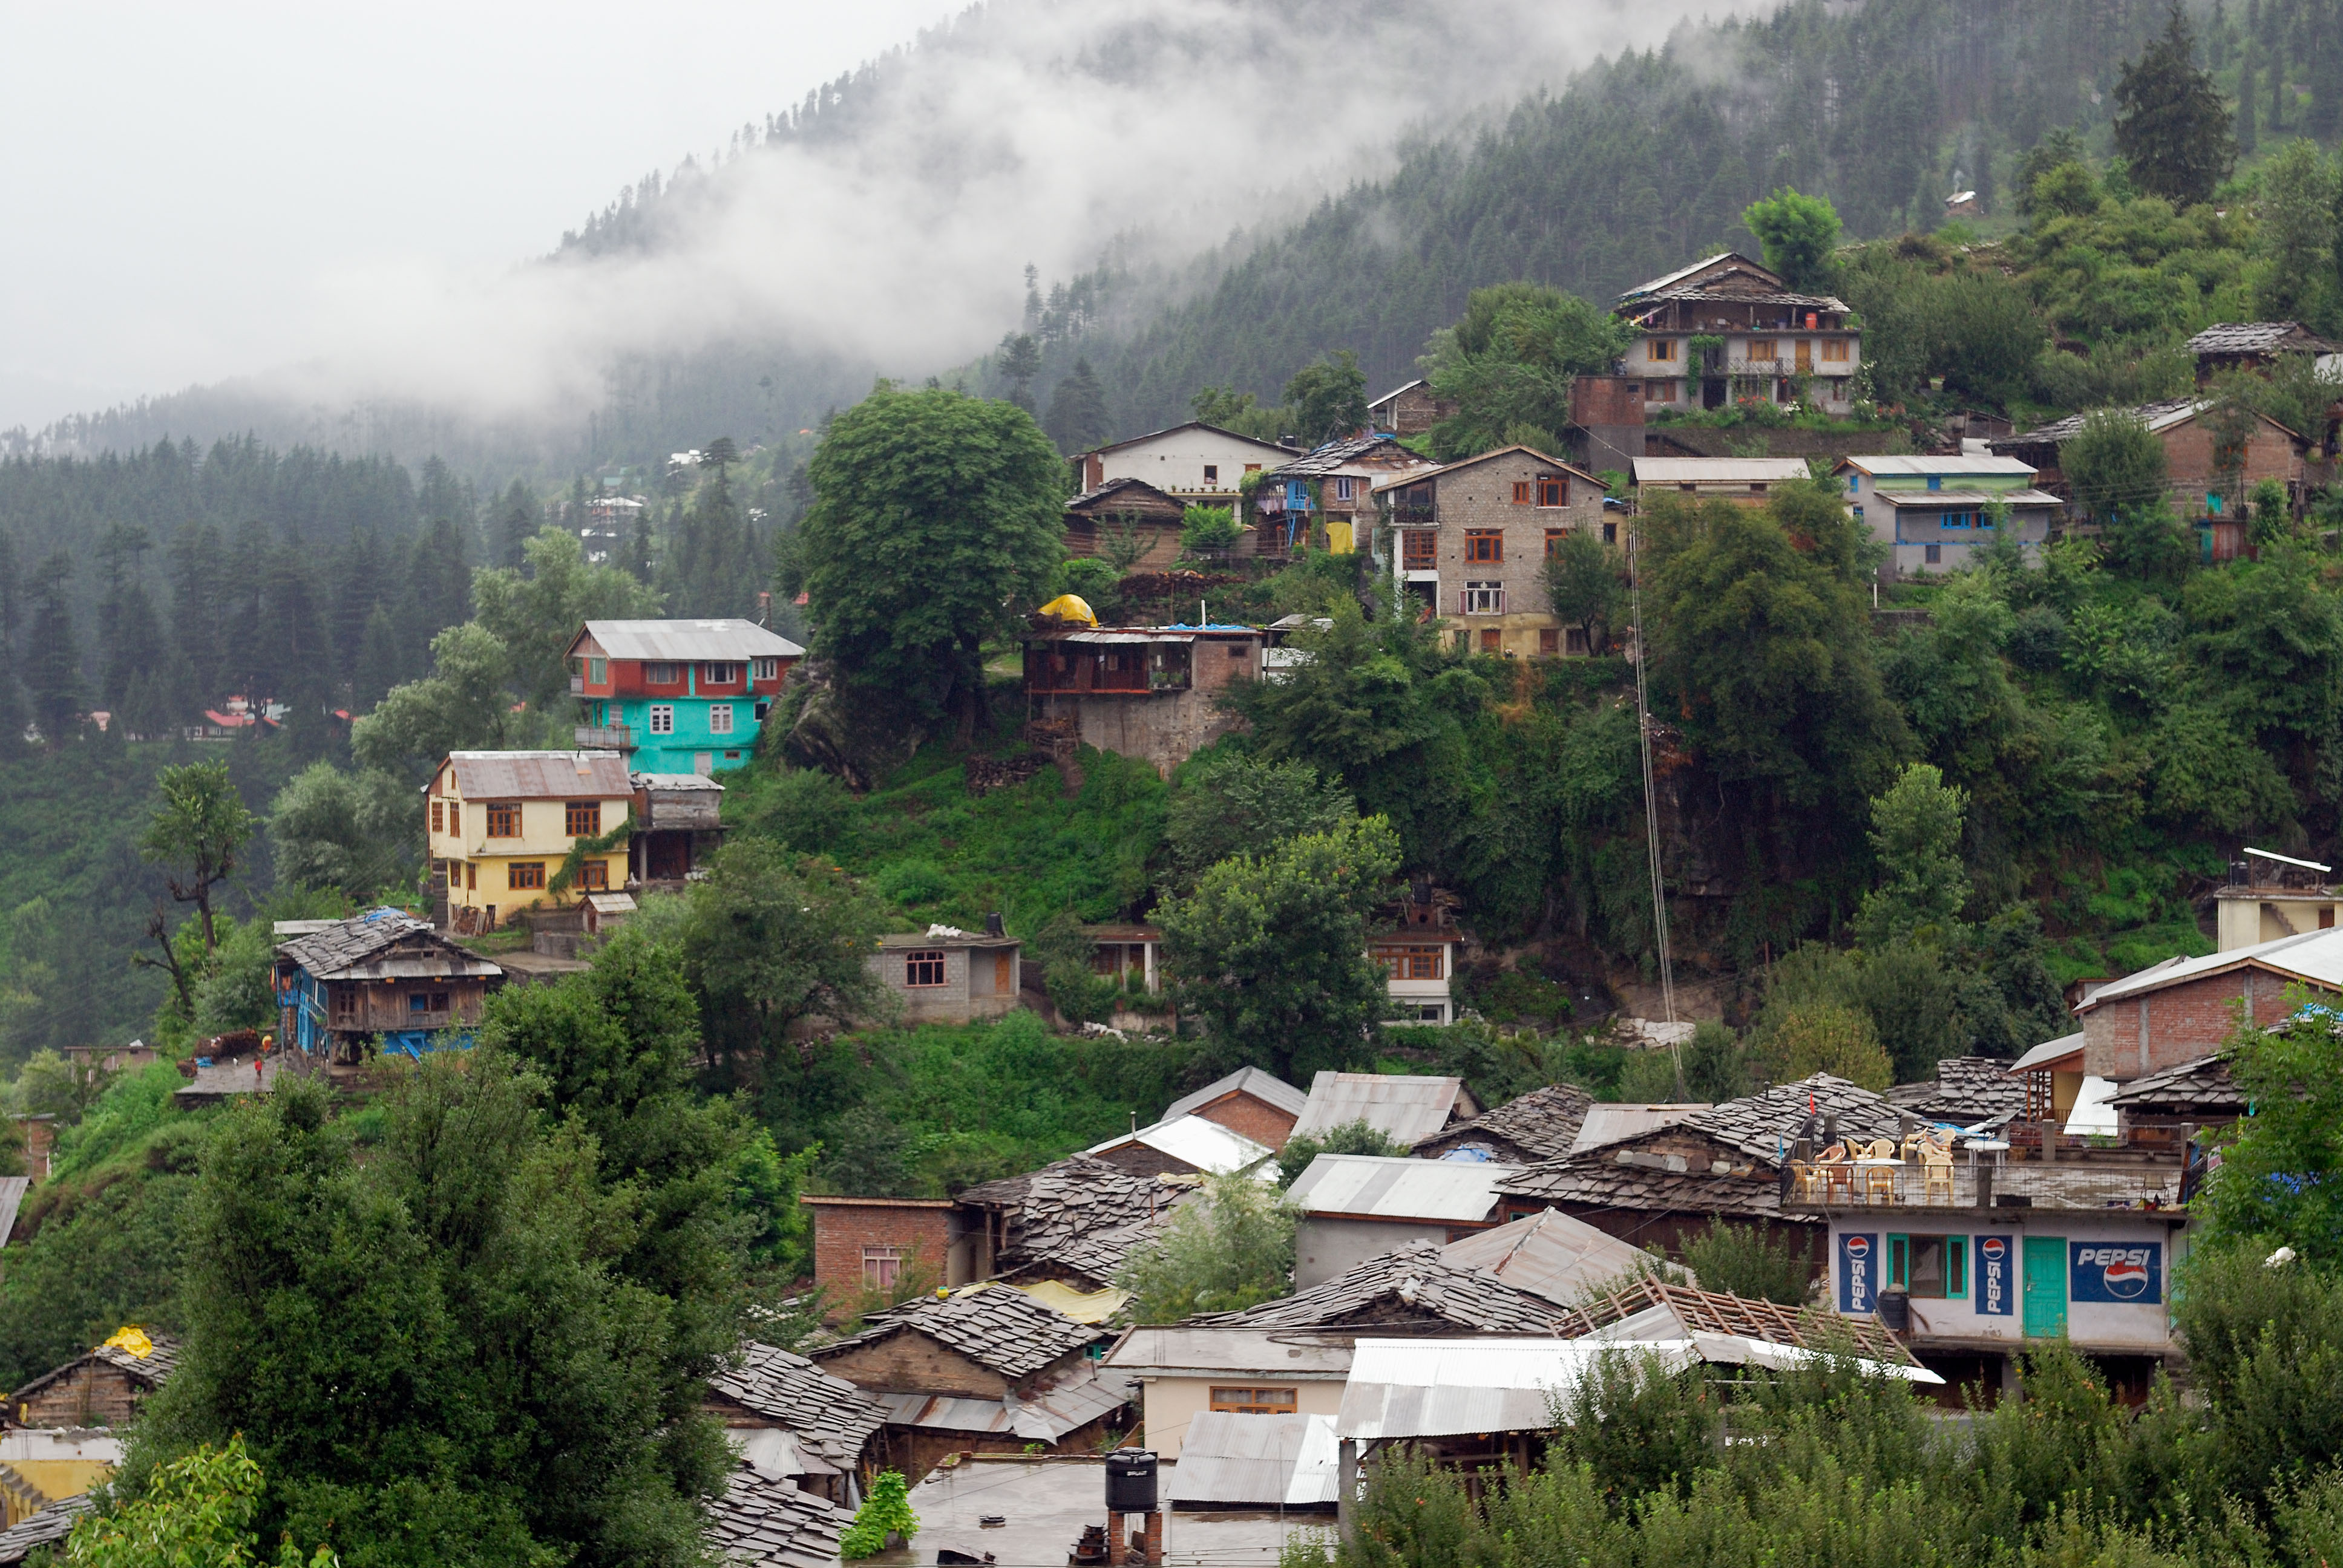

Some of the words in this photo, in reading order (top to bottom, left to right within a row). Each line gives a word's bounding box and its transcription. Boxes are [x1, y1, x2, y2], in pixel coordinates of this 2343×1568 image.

[2077, 1248, 2151, 1266] PEPSI
[1852, 1259, 1866, 1311] PEPSI
[1987, 1261, 2001, 1313] PEPSI
